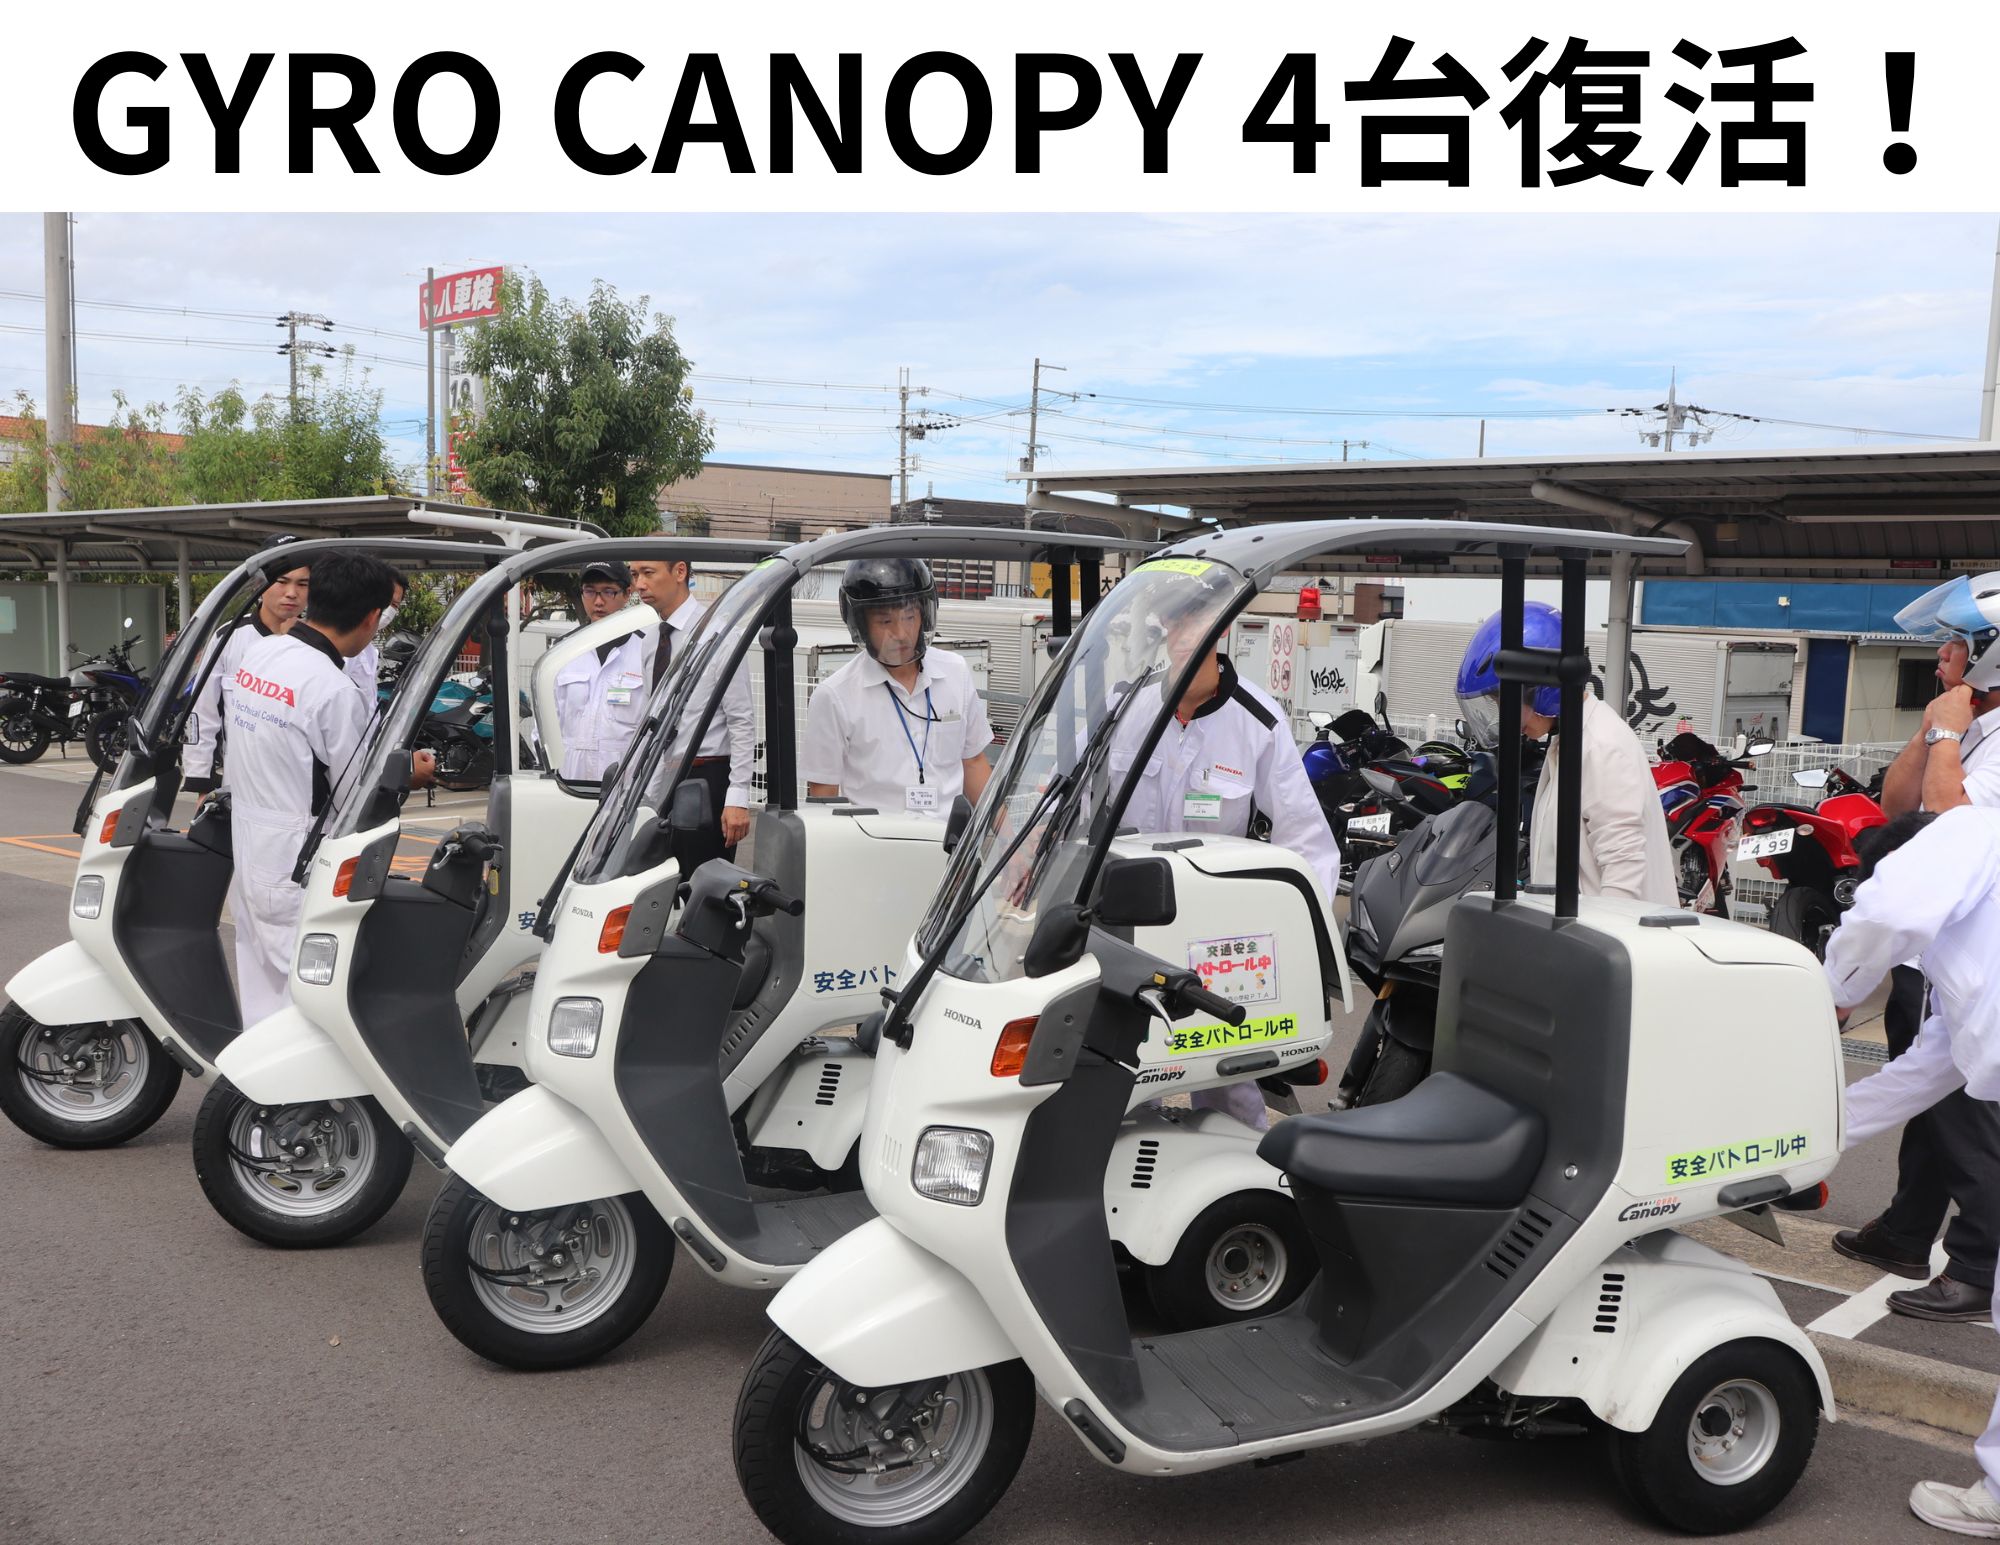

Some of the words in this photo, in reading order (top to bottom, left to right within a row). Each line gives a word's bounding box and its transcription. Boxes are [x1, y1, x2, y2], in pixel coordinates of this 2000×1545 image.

[261, 711, 288, 729] College
[1215, 764, 1243, 776] HONDA
[571, 906, 594, 919] HONDA
[1207, 941, 1258, 957] 交通安全
[1196, 955, 1272, 976] パトロール中
[814, 964, 897, 993] 安全パト
[943, 1008, 983, 1030] HONDA
[1173, 1017, 1294, 1051] 安全パトロール中
[1280, 1044, 1321, 1058] HONDA
[1671, 1134, 1806, 1179] 安全パトロール中
[1618, 1202, 1681, 1222] Canopy
